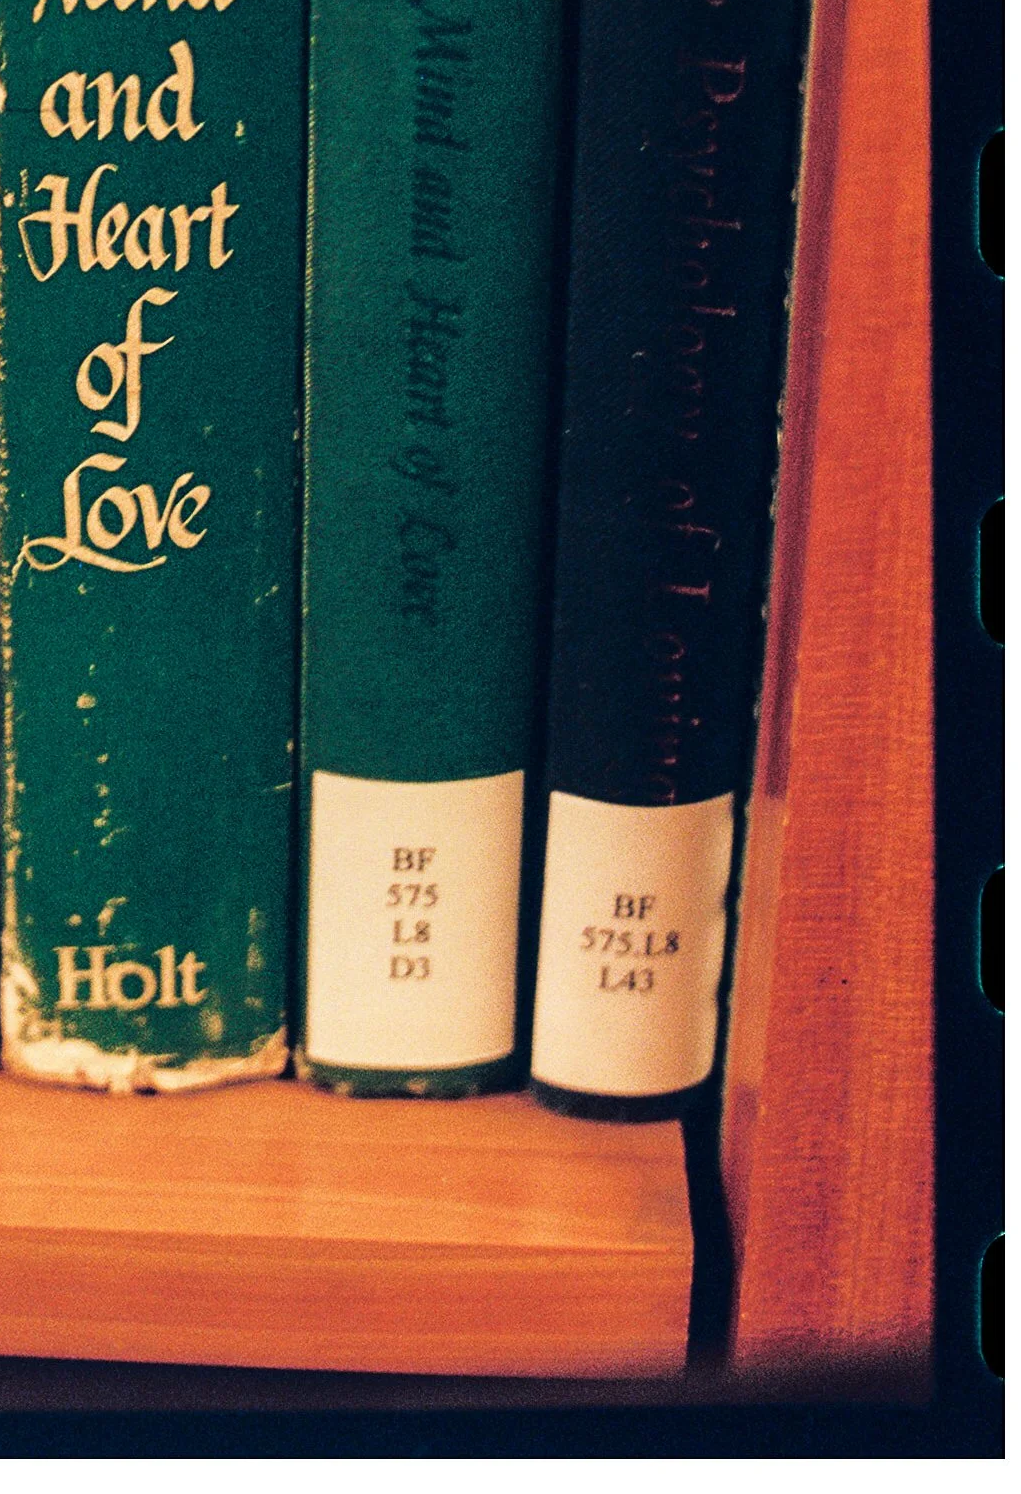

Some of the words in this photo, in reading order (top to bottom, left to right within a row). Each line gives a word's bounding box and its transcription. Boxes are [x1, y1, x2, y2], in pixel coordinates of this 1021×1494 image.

[38, 38, 204, 144] and
[18, 164, 238, 282] Heart
[410, 166, 468, 266] and
[76, 288, 178, 442] of
[404, 282, 463, 432] Heart
[390, 442, 460, 498] of
[24, 452, 212, 572] Love
[391, 846, 437, 872] BF
[386, 883, 439, 908] 575
[613, 893, 656, 920] BF
[392, 919, 431, 945] L8
[580, 925, 680, 957] 575.L8
[56, 944, 208, 1011] Holt
[389, 955, 431, 980] D3
[598, 965, 656, 993] L43
